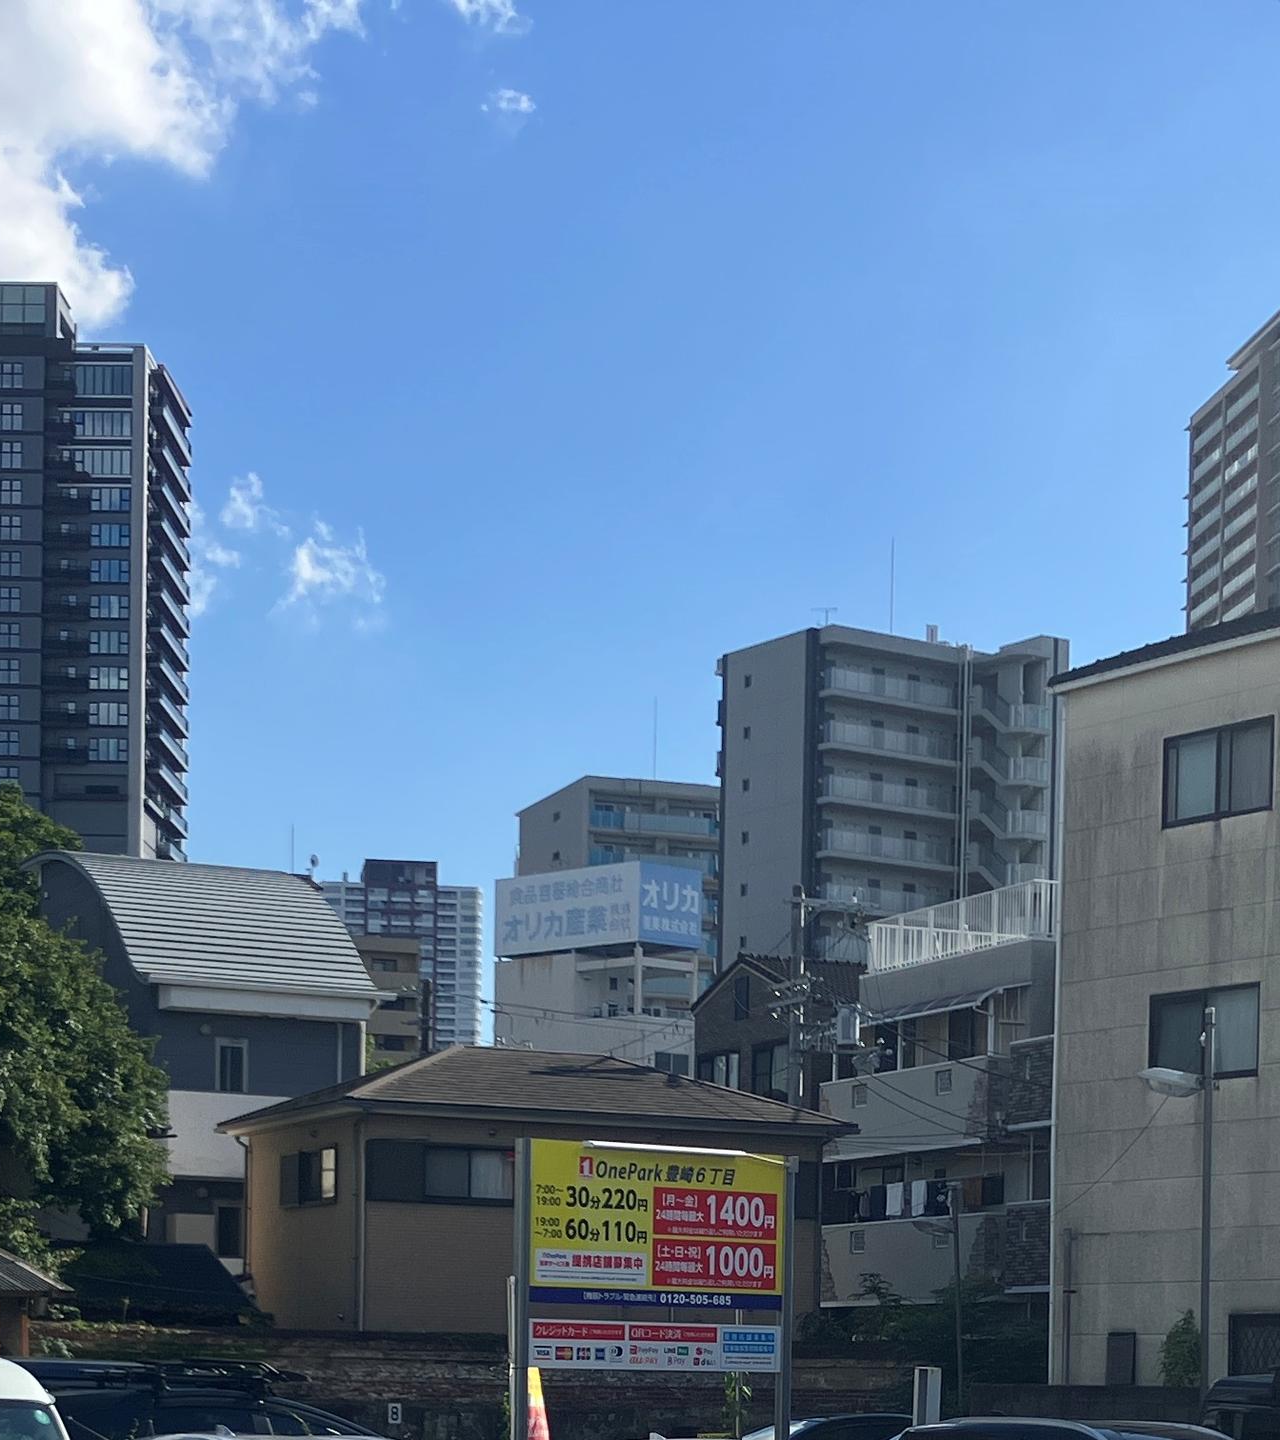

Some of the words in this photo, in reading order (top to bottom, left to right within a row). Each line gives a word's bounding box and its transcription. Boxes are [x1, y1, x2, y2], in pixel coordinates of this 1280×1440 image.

[641, 879, 699, 914] オリカ
[596, 1160, 662, 1182] OnePark
[536, 1196, 561, 1206] 19:00
[535, 1217, 560, 1227] 19:00
[660, 1292, 732, 1306] 0120-505-685
[391, 1406, 399, 1421] 8
